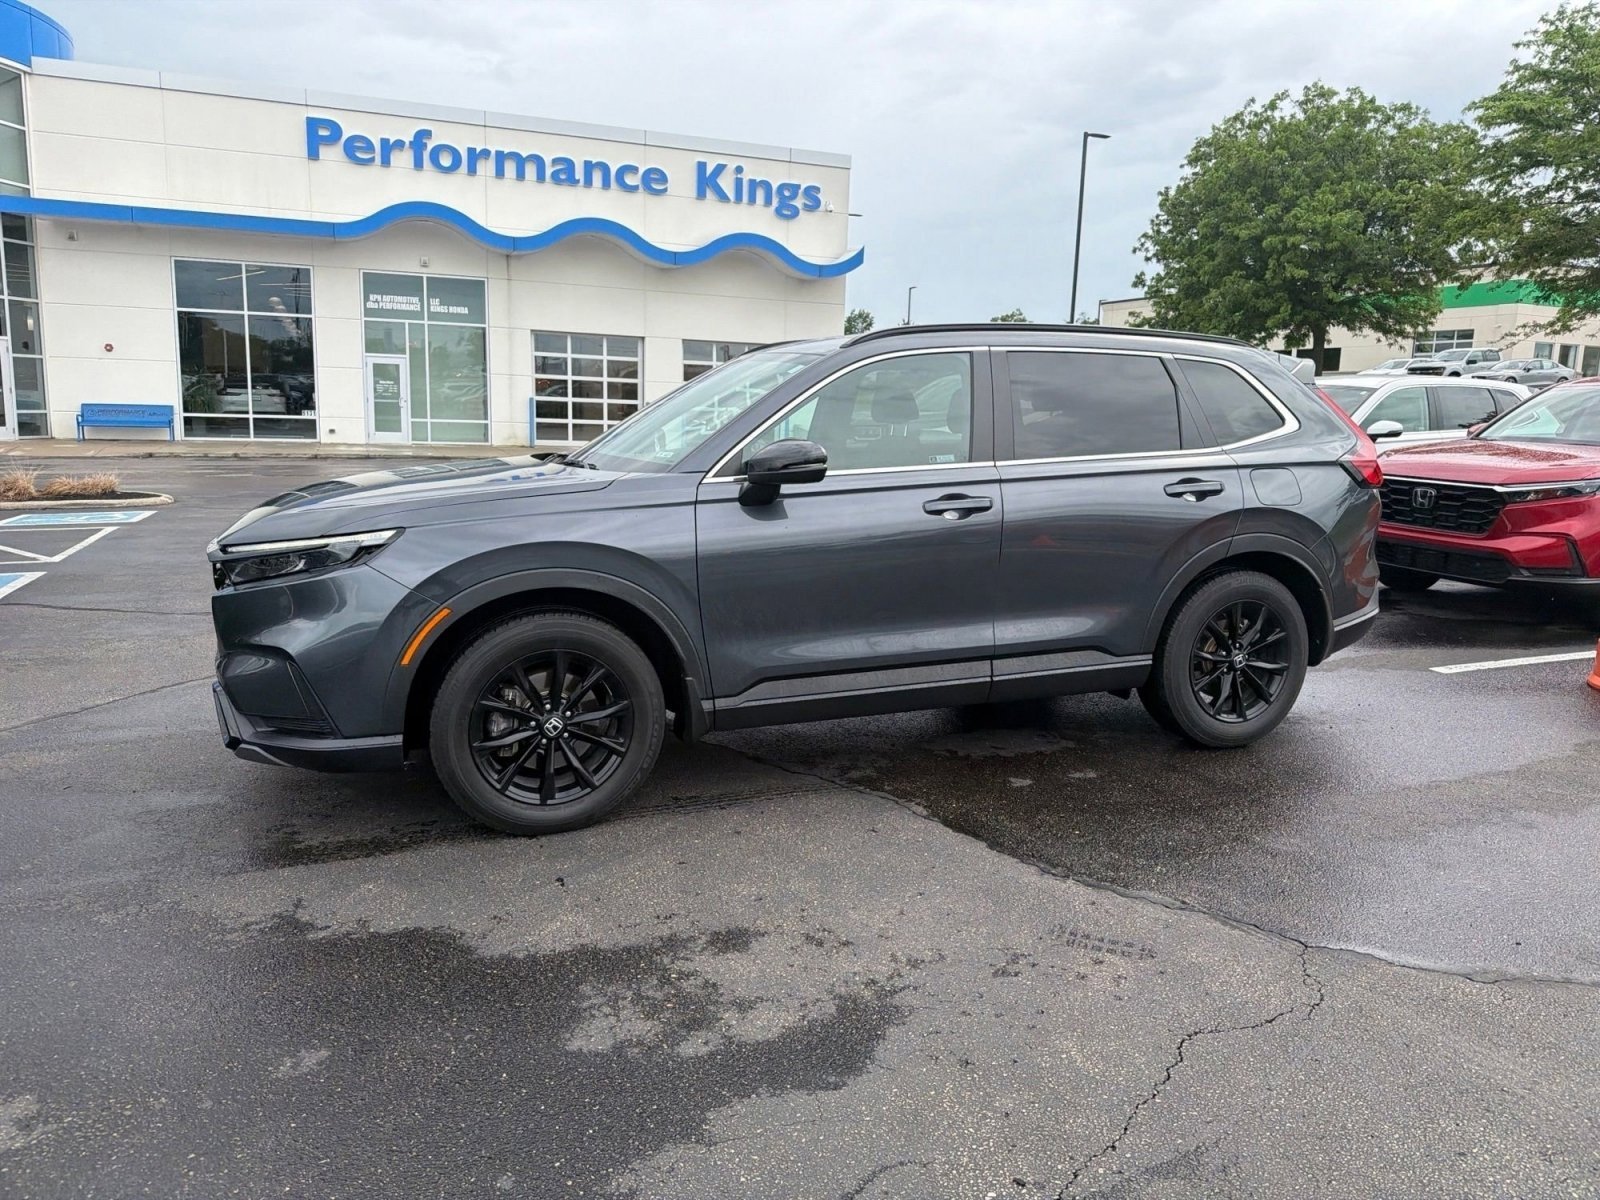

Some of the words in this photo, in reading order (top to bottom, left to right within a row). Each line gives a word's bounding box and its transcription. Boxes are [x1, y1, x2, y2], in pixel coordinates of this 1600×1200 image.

[305, 116, 669, 195] Performance
[696, 161, 822, 220] Kings
[379, 302, 421, 312] PERFORMANCE
[430, 305, 448, 313] KINGS
[448, 306, 469, 314] HONDA
